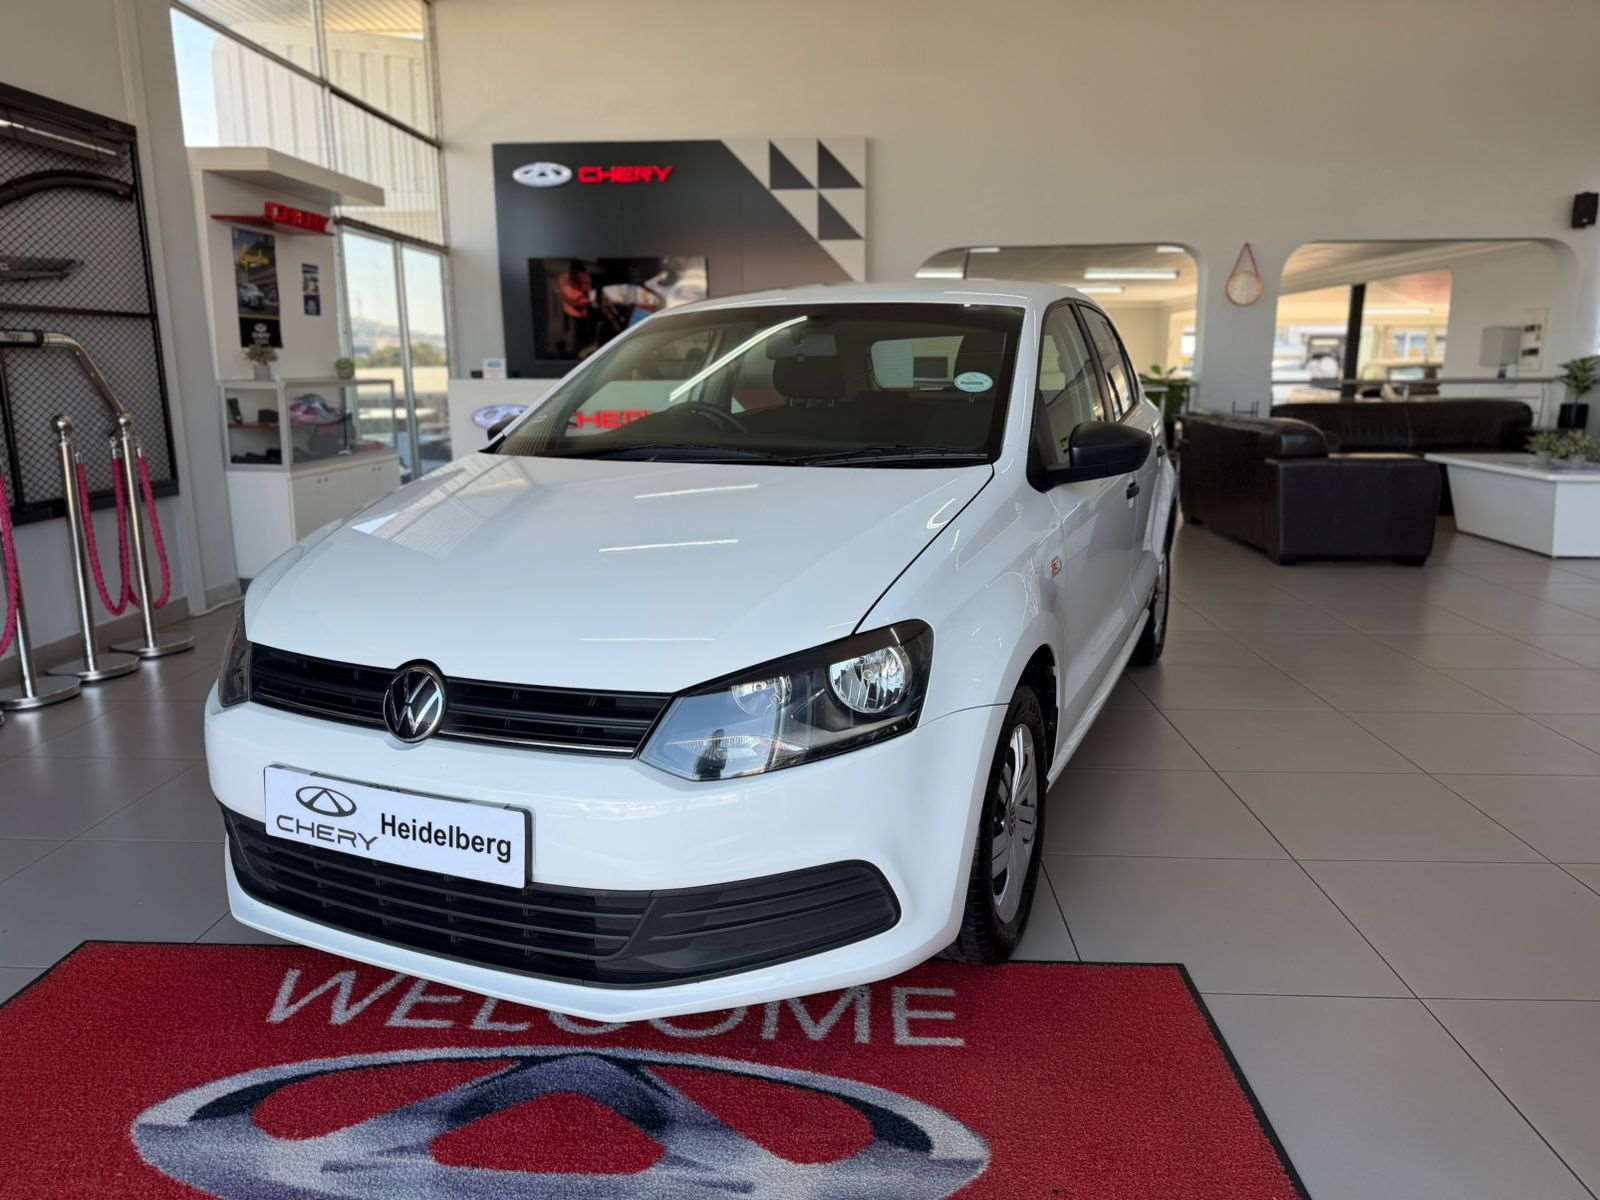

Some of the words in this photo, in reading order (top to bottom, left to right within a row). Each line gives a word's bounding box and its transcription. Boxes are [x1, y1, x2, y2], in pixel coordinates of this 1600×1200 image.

[578, 165, 673, 184] CHERY
[565, 408, 654, 431] HER
[276, 814, 378, 851] CHERY
[380, 812, 512, 863] Heidelberg
[265, 967, 965, 1047] WELME
